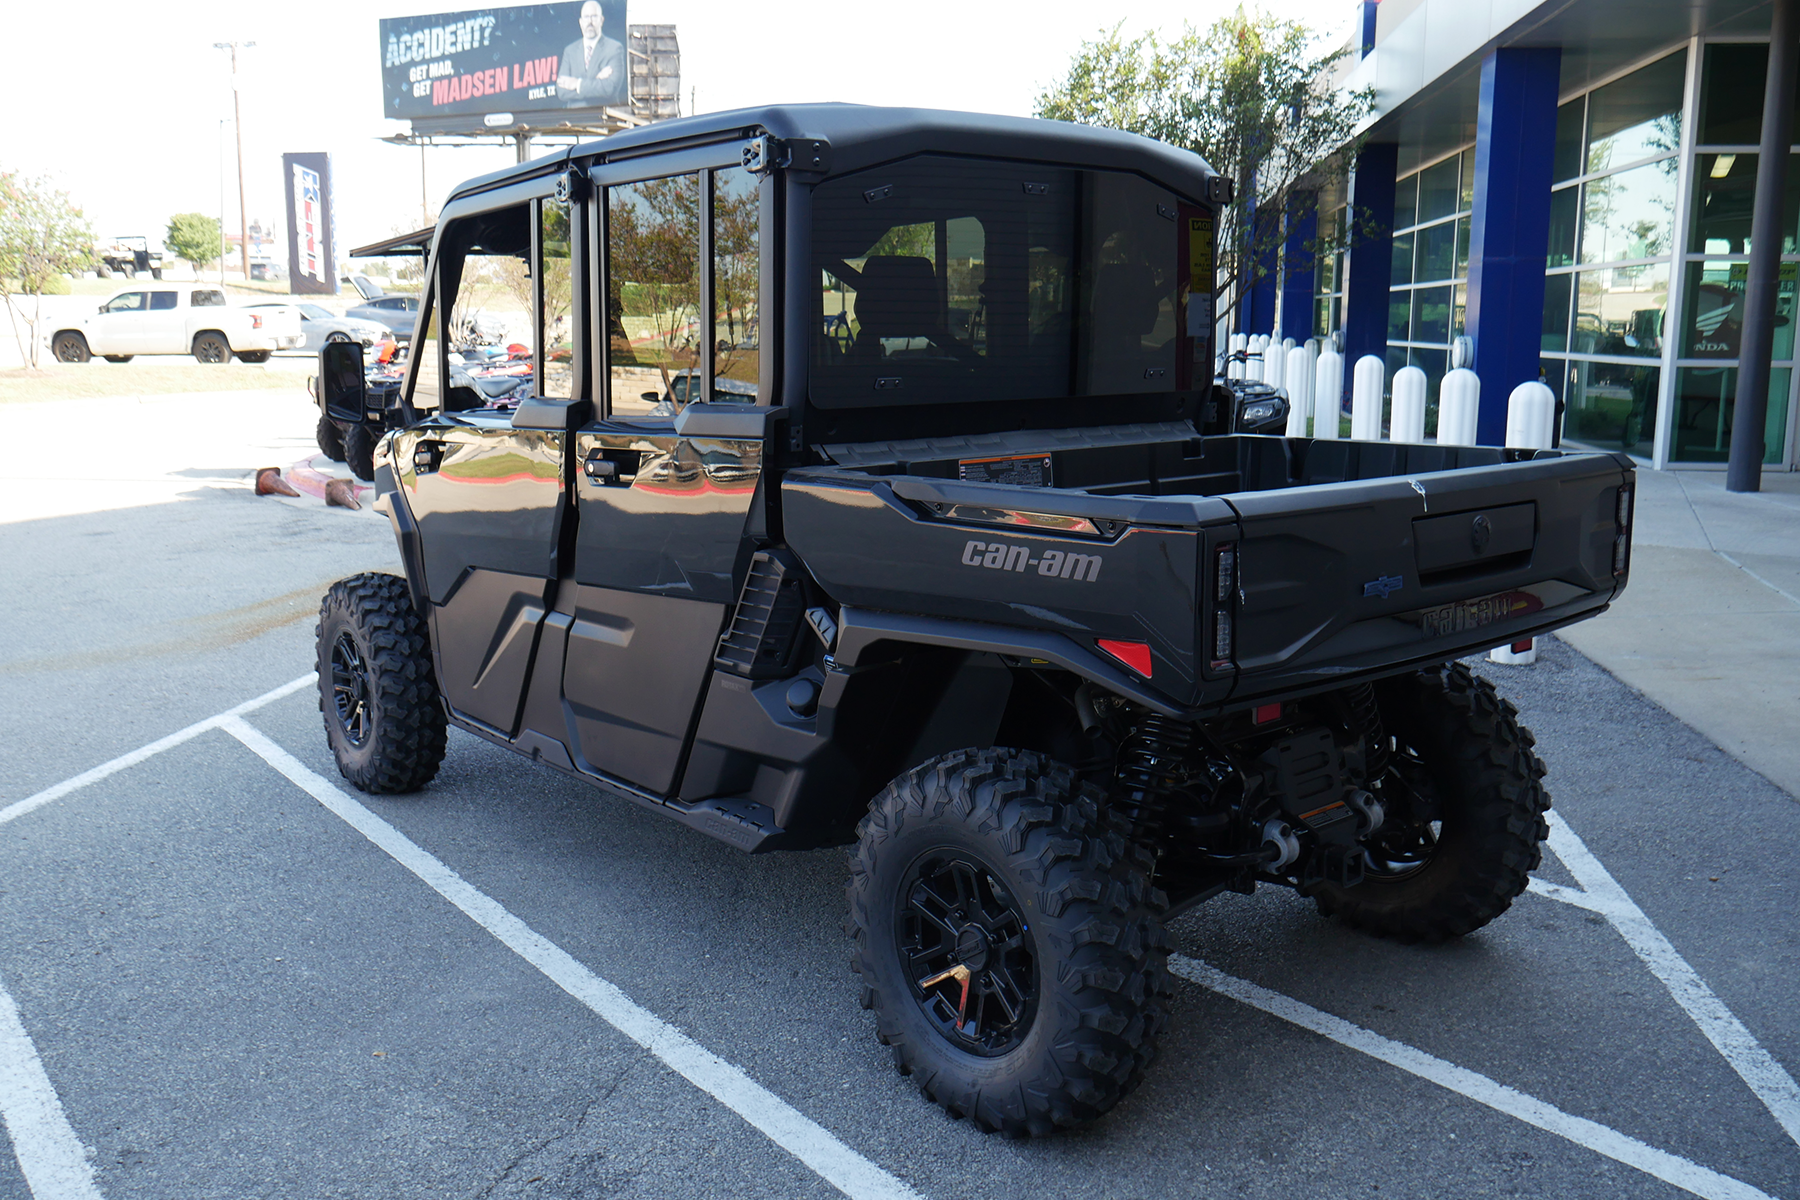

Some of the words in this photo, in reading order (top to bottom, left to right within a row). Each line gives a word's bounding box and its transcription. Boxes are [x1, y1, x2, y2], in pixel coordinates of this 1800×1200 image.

[385, 16, 495, 67] ACCIDENT?
[409, 63, 427, 82] GET
[429, 60, 454, 77] MAD,
[413, 81, 432, 98] GET
[432, 66, 508, 106] MADSEN
[513, 55, 558, 89] LAW!
[529, 88, 546, 100] KYLE,
[548, 85, 556, 97] TX
[302, 168, 324, 282] KENT
[1693, 342, 1730, 351] NDA
[961, 540, 1103, 583] can-am
